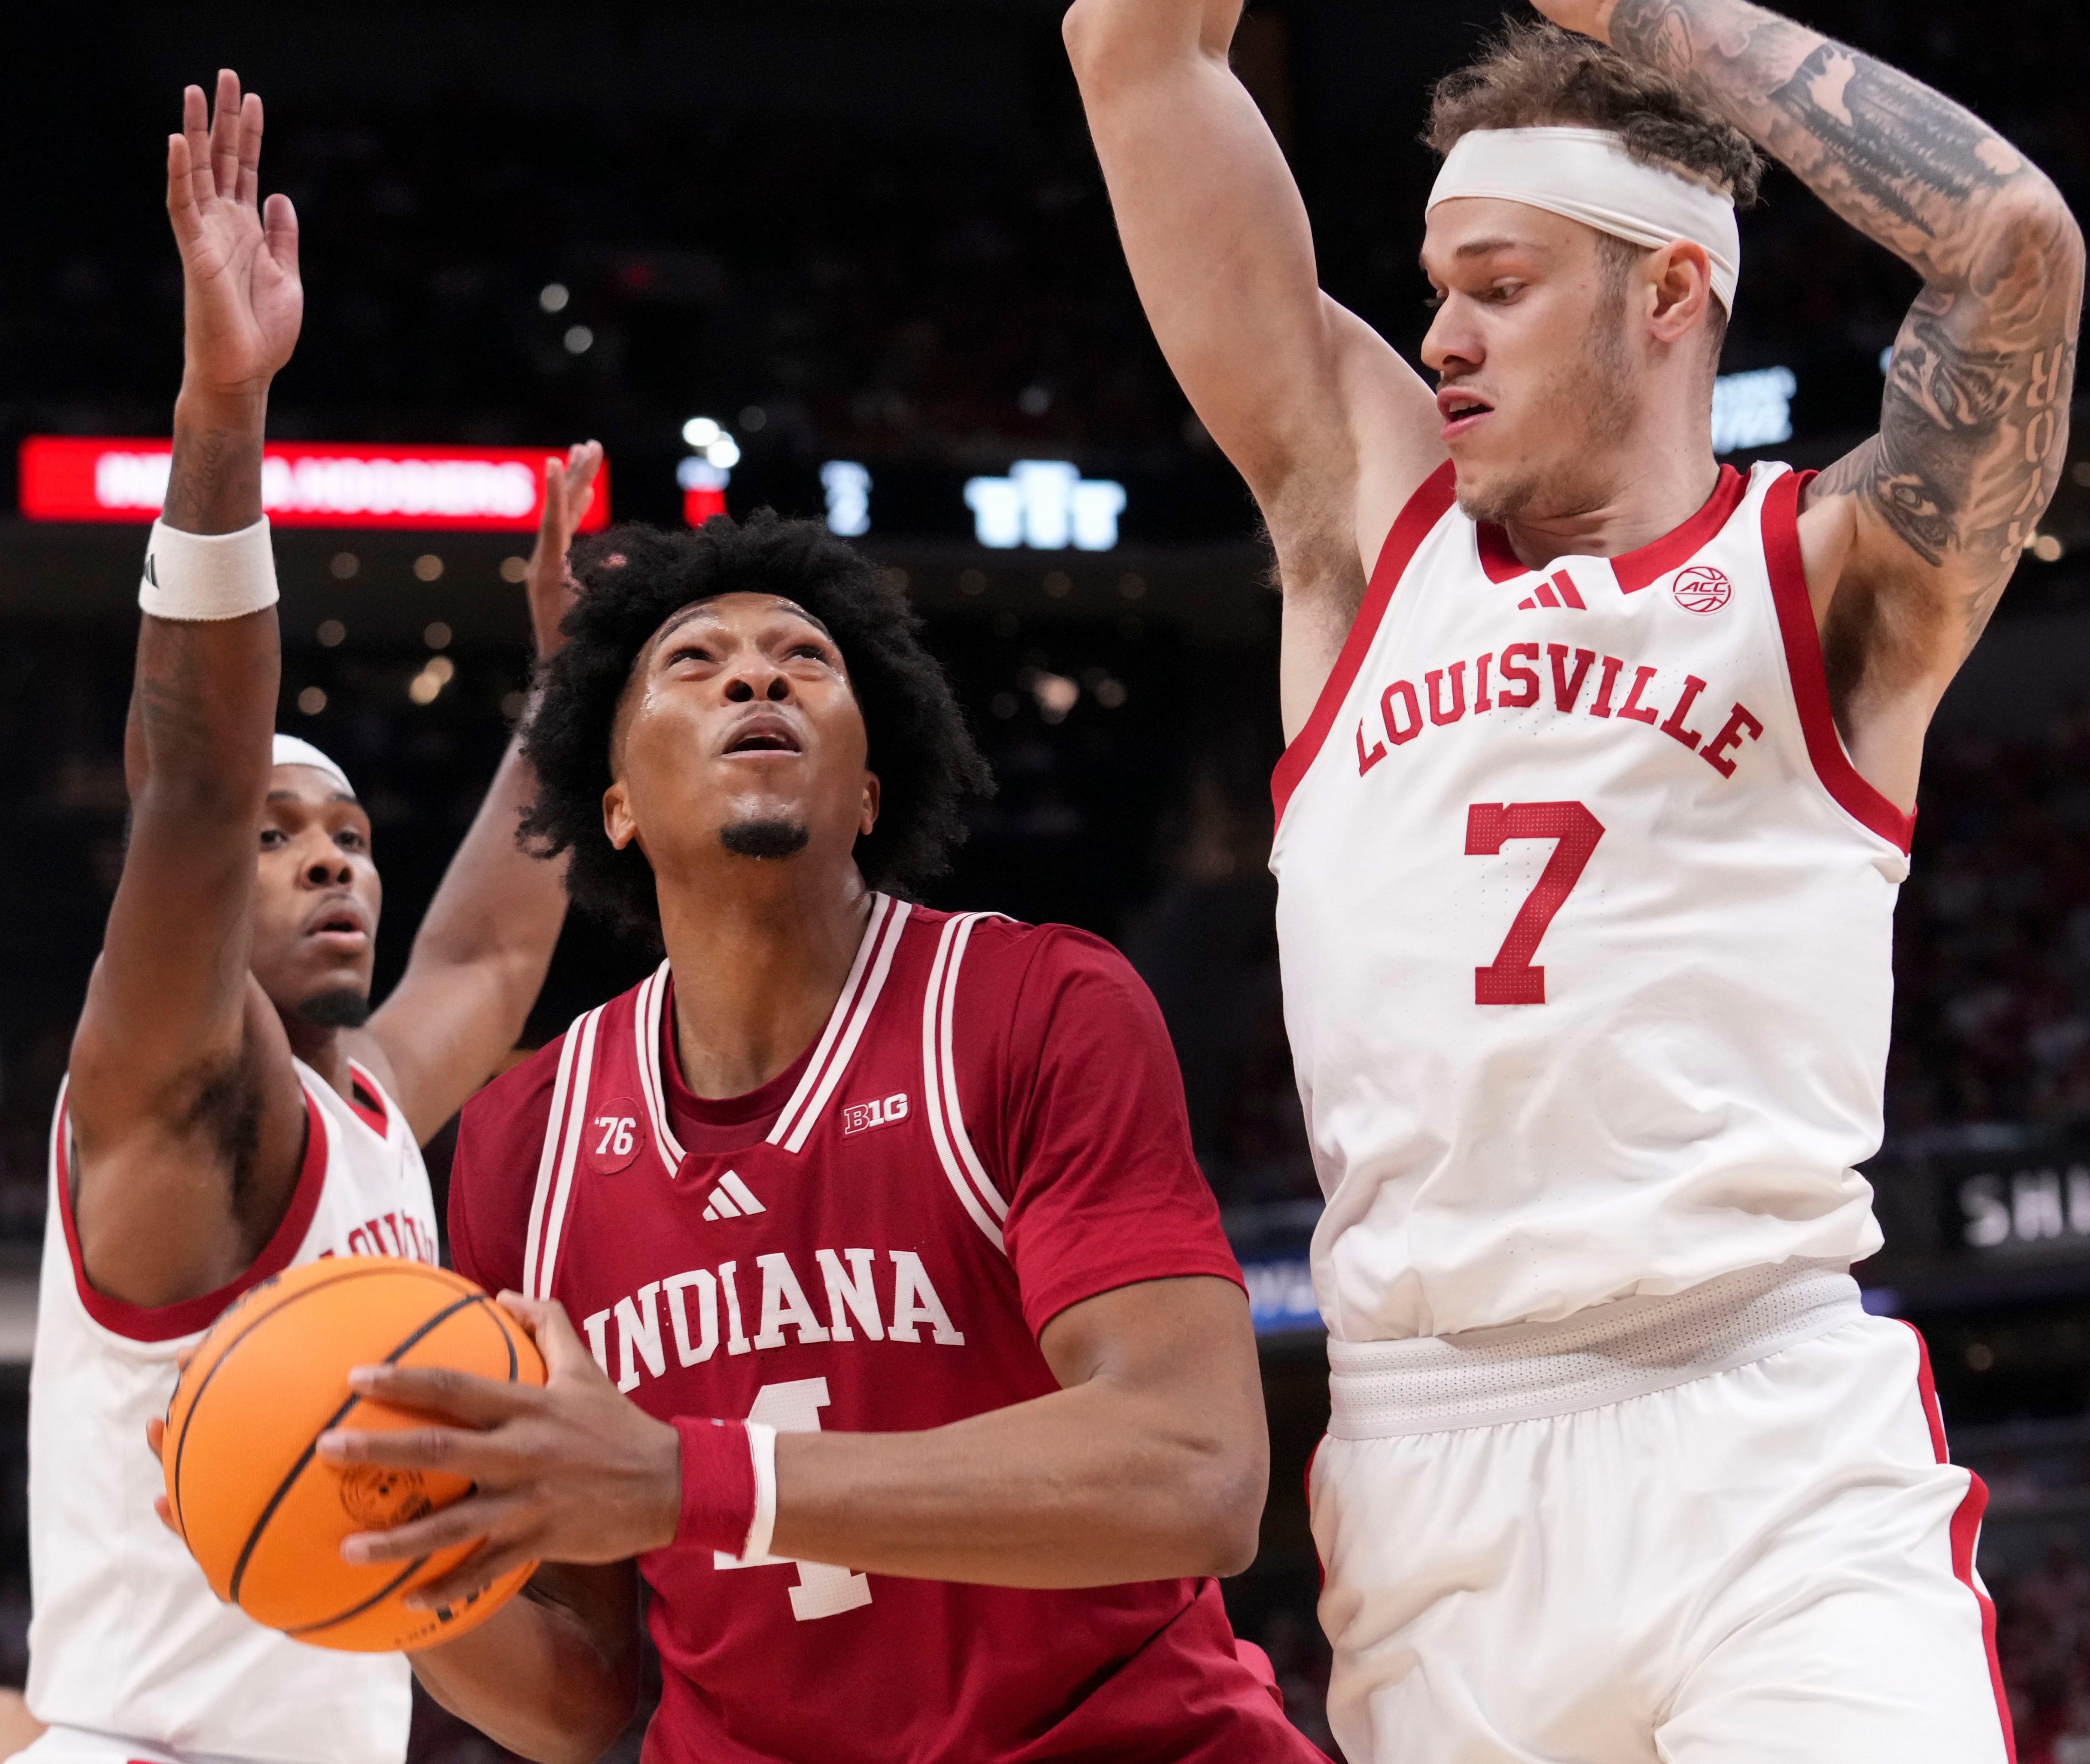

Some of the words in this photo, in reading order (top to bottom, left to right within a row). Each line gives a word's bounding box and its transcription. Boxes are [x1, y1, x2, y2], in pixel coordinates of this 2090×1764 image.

[1679, 582, 1729, 592] ACC
[1356, 642, 1764, 779] LOUISVILLE
[1464, 801, 1606, 1005] 7
[583, 1248, 965, 1395] INDIANA
[713, 1376, 872, 1621] 4
